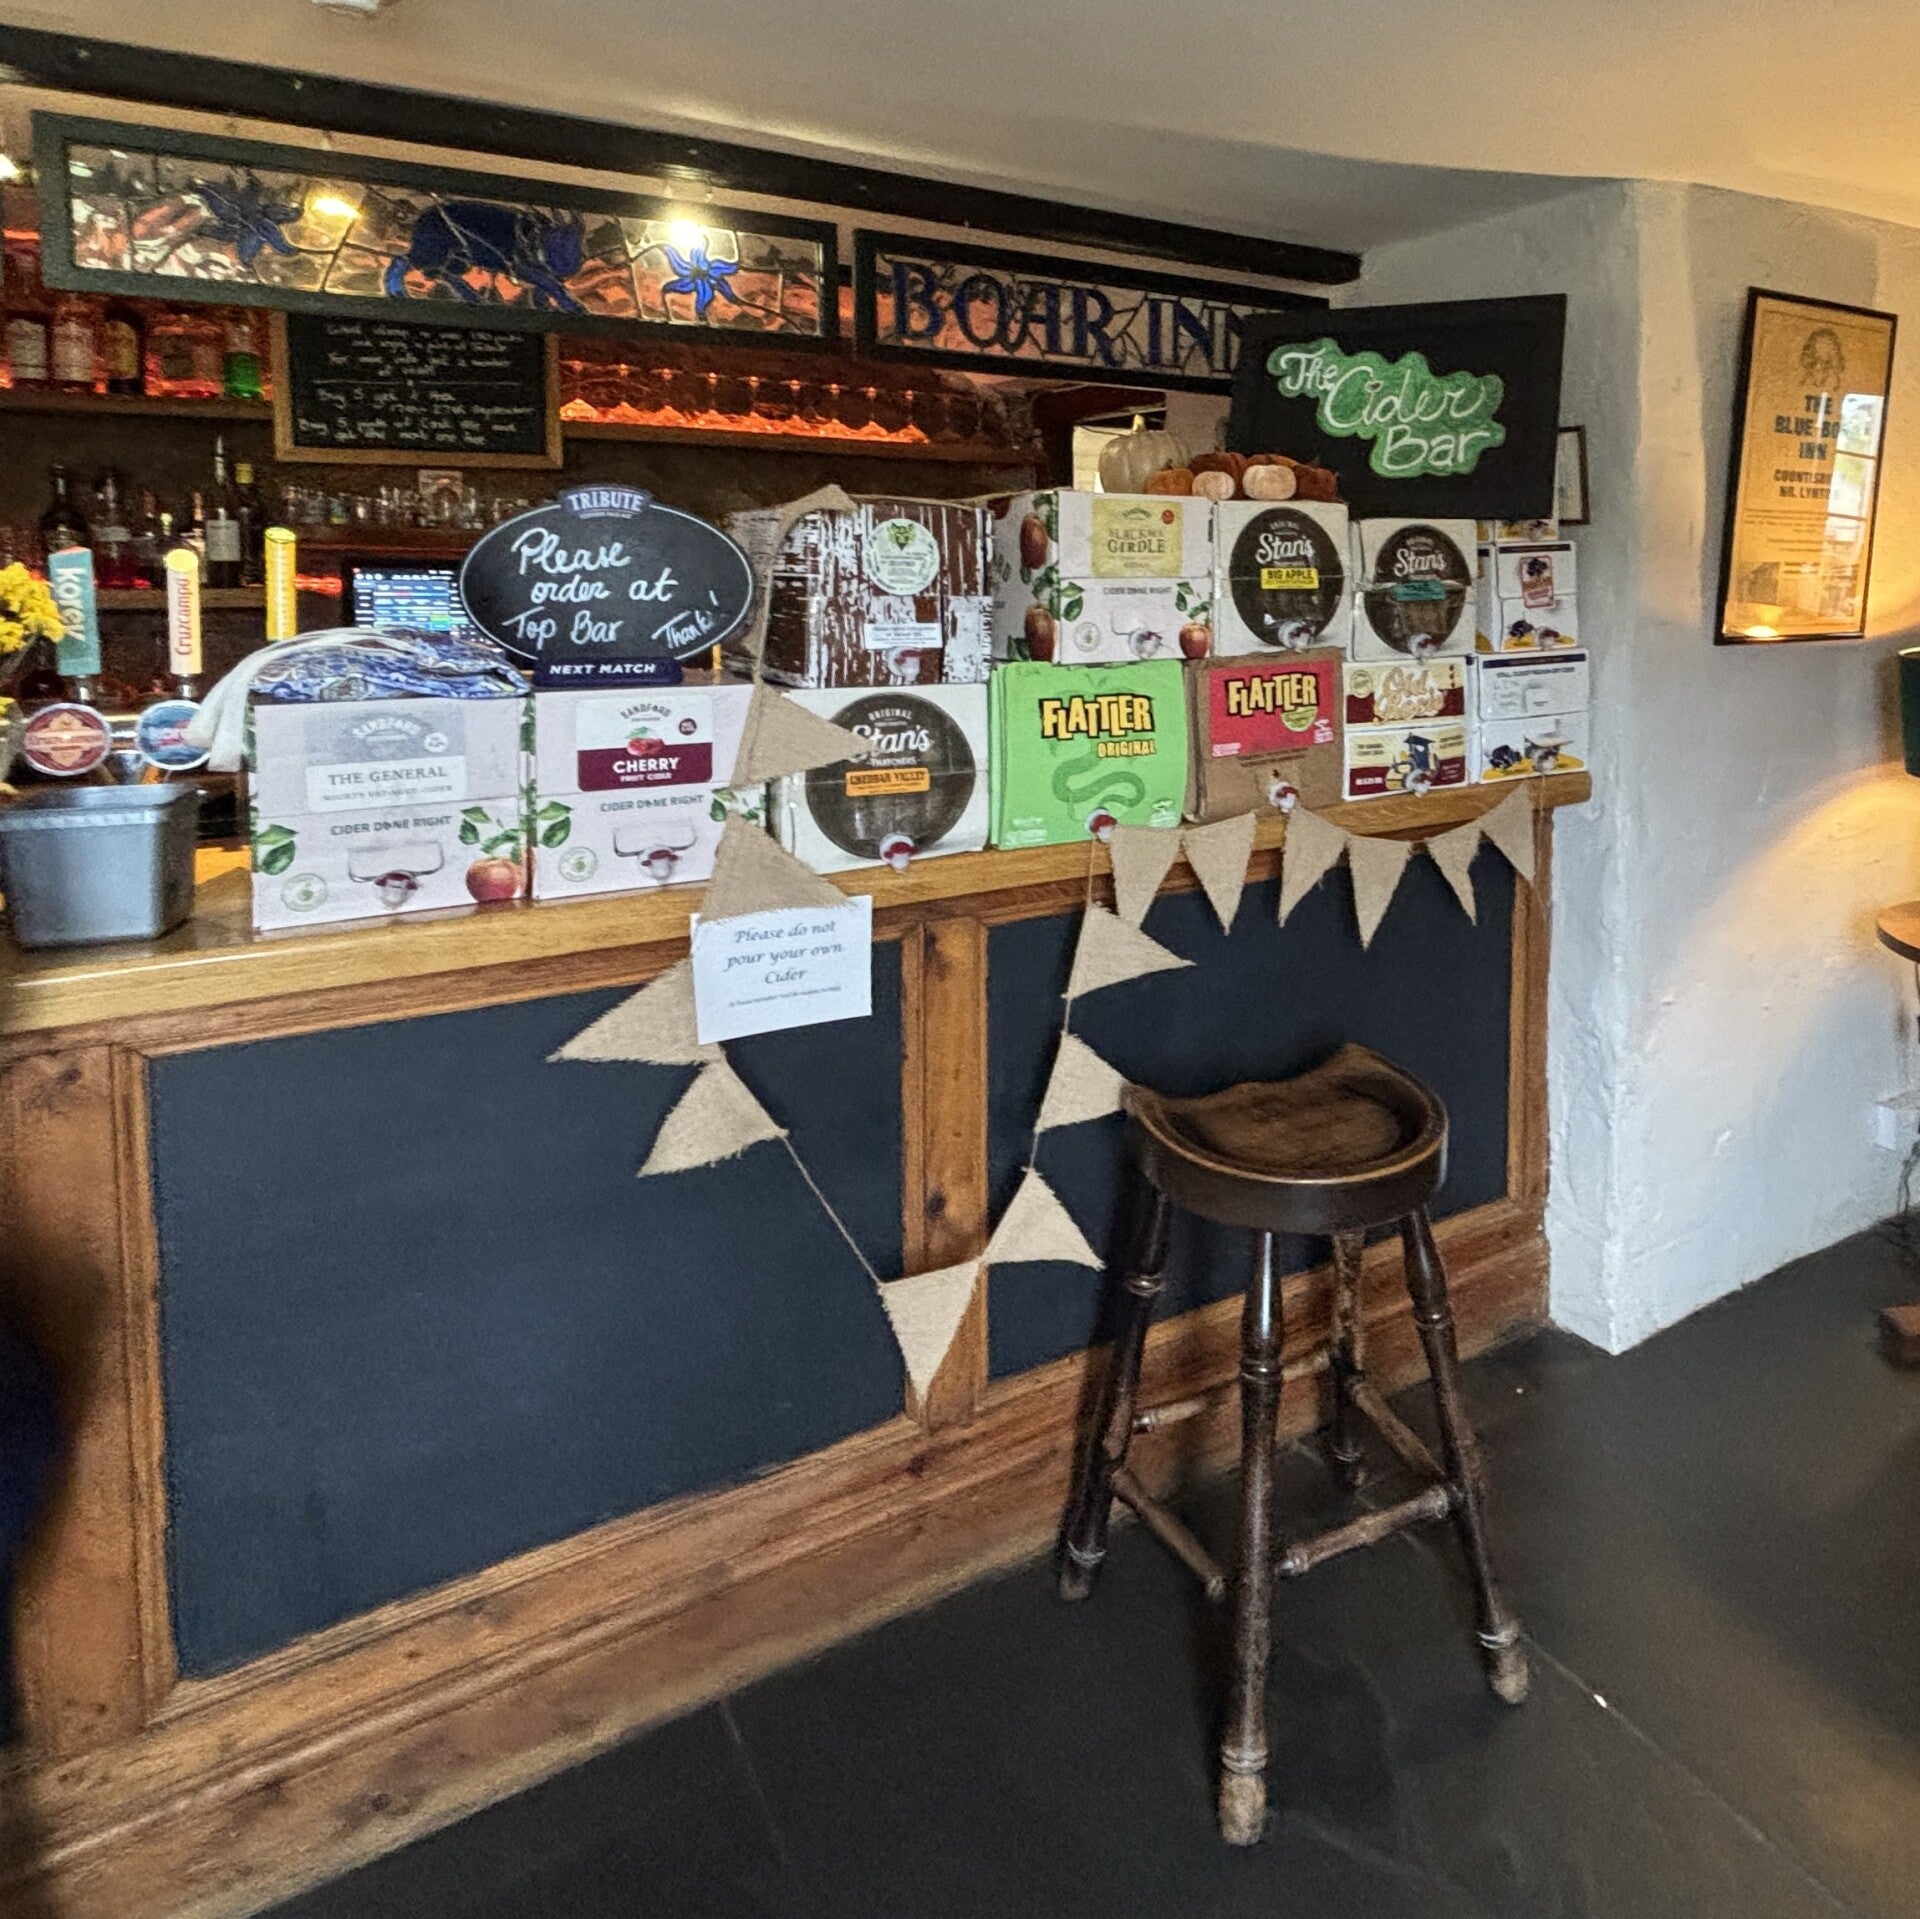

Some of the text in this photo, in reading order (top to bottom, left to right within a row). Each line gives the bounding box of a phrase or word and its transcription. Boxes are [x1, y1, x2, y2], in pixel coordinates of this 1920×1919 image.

[889, 261, 1124, 368] BOAR
[1280, 347, 1339, 391] The
[1324, 366, 1487, 429] Cider
[1382, 424, 1491, 471] Bar
[567, 489, 645, 513] TRIBUTE
[511, 526, 632, 575] Please
[1107, 538, 1166, 553] GIRDLE
[1255, 532, 1315, 564] Stan's
[1267, 569, 1315, 580] BIG APPLE
[1393, 547, 1447, 578] Stan's
[530, 567, 679, 603] order at
[175, 577, 192, 656] Cruzcampo
[502, 606, 558, 650] Top
[570, 610, 624, 645] Bar
[550, 663, 656, 676] NEXT MATCH
[1225, 671, 1319, 717] FLATTLER
[620, 703, 672, 720] SANDFORD
[1040, 693, 1155, 740] FLATTLER
[1097, 739, 1157, 758] ORIGINAL
[328, 766, 449, 786] THE GENERAL
[612, 756, 680, 775] CHERRY
[600, 801, 635, 813] CIDER
[670, 794, 704, 806] RIGHT
[330, 823, 370, 836] CIDER
[413, 815, 452, 828] RIGHT
[734, 920, 836, 944] Please do not
[722, 942, 842, 972] pour your own
[764, 968, 808, 985] Cider
